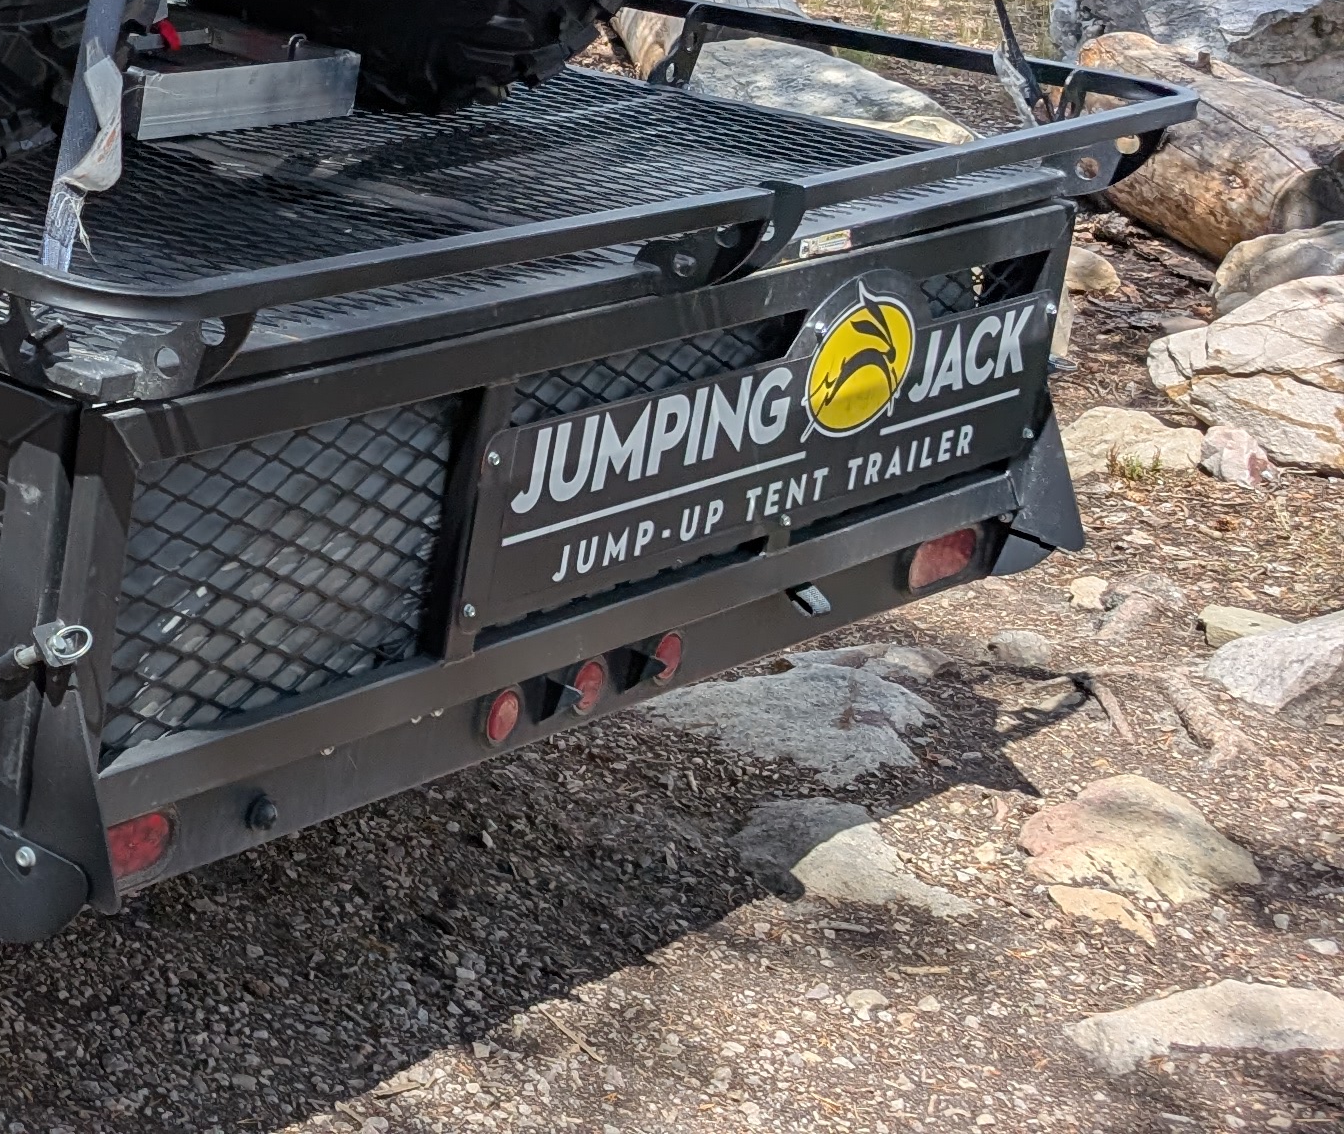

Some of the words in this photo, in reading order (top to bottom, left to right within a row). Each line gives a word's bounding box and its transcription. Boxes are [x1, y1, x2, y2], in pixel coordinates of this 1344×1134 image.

[510, 367, 793, 513] JUMPING
[907, 304, 1034, 403] JACK
[552, 499, 723, 582] JUMP-UP
[745, 466, 830, 522] TENT
[848, 424, 974, 491] TRAILER
